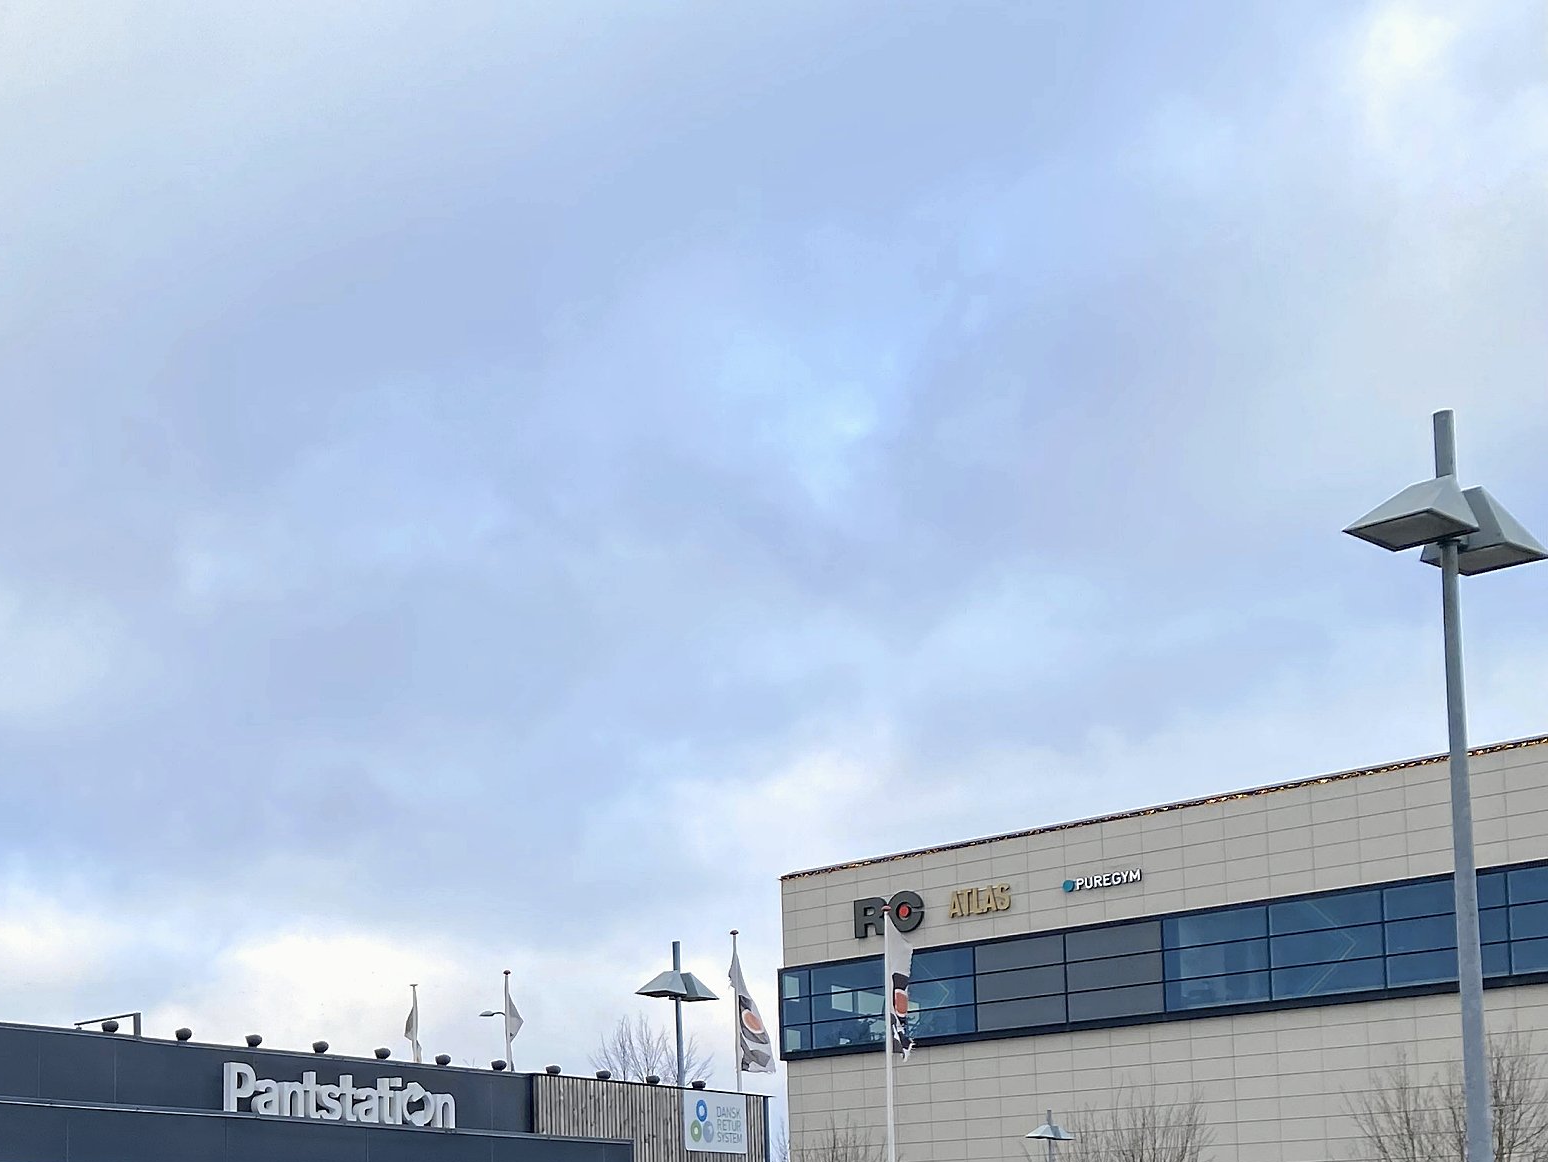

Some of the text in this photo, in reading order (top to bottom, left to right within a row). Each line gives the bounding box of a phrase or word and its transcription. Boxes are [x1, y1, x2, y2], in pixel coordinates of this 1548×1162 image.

[1074, 868, 1142, 891] PUREGYM
[948, 883, 1012, 919] ATLAS
[223, 1061, 456, 1129] Pantstation
[716, 1106, 741, 1119] DANSK
[716, 1119, 742, 1131] RETUR
[717, 1132, 743, 1144] SYSTEM
